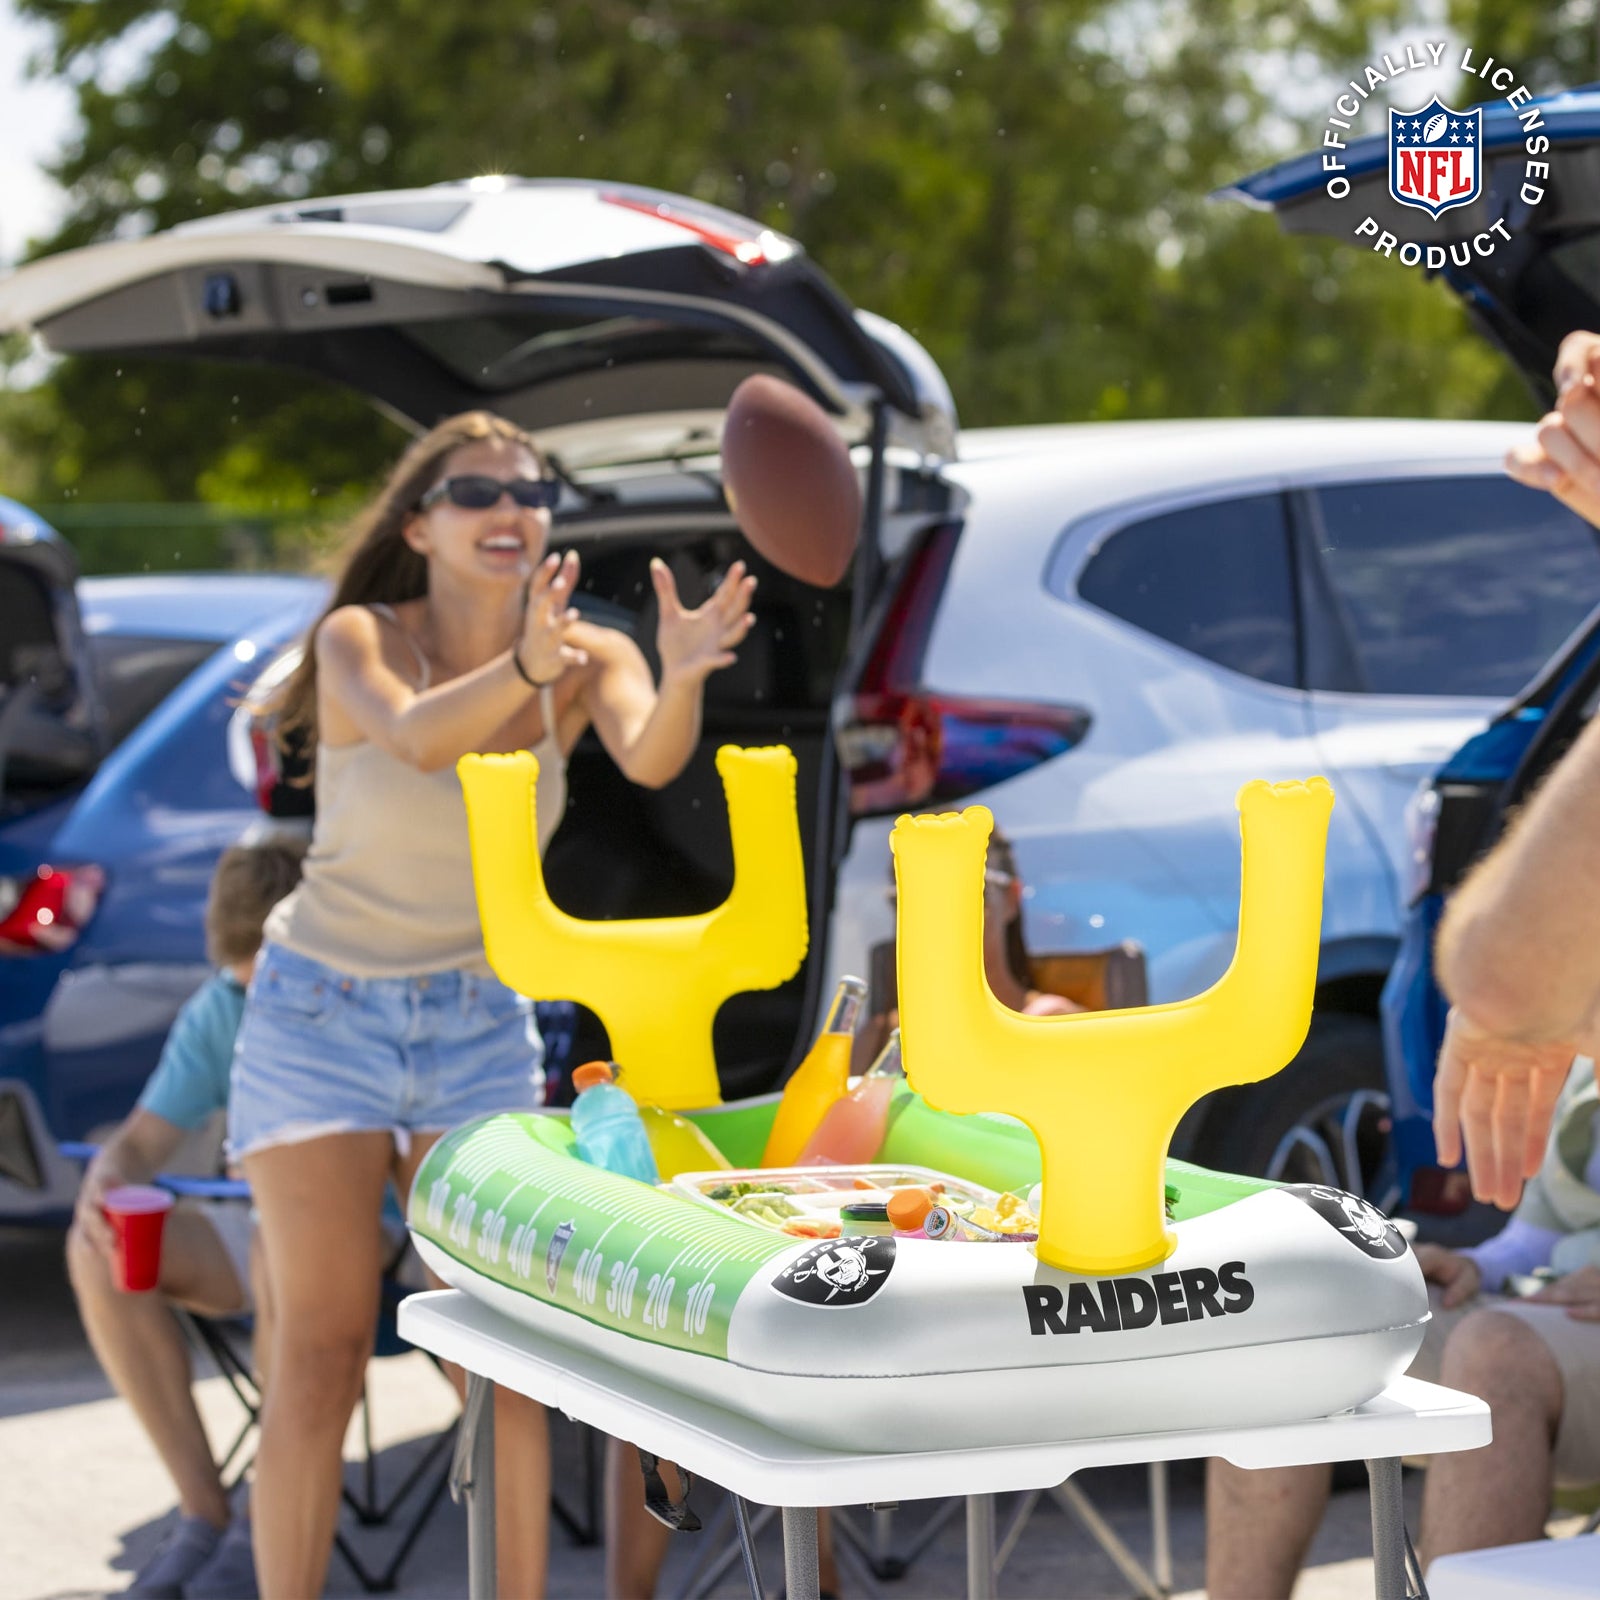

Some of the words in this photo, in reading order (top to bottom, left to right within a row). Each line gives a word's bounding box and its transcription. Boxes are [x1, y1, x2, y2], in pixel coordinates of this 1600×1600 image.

[477, 1209, 506, 1264] 30
[507, 1224, 537, 1280] 40
[572, 1248, 602, 1305] 40
[606, 1260, 638, 1319] 30
[642, 1273, 675, 1330] 20
[683, 1282, 715, 1337] 10
[781, 1235, 873, 1278] RAIDE
[1022, 1261, 1255, 1335] RAIDERS
